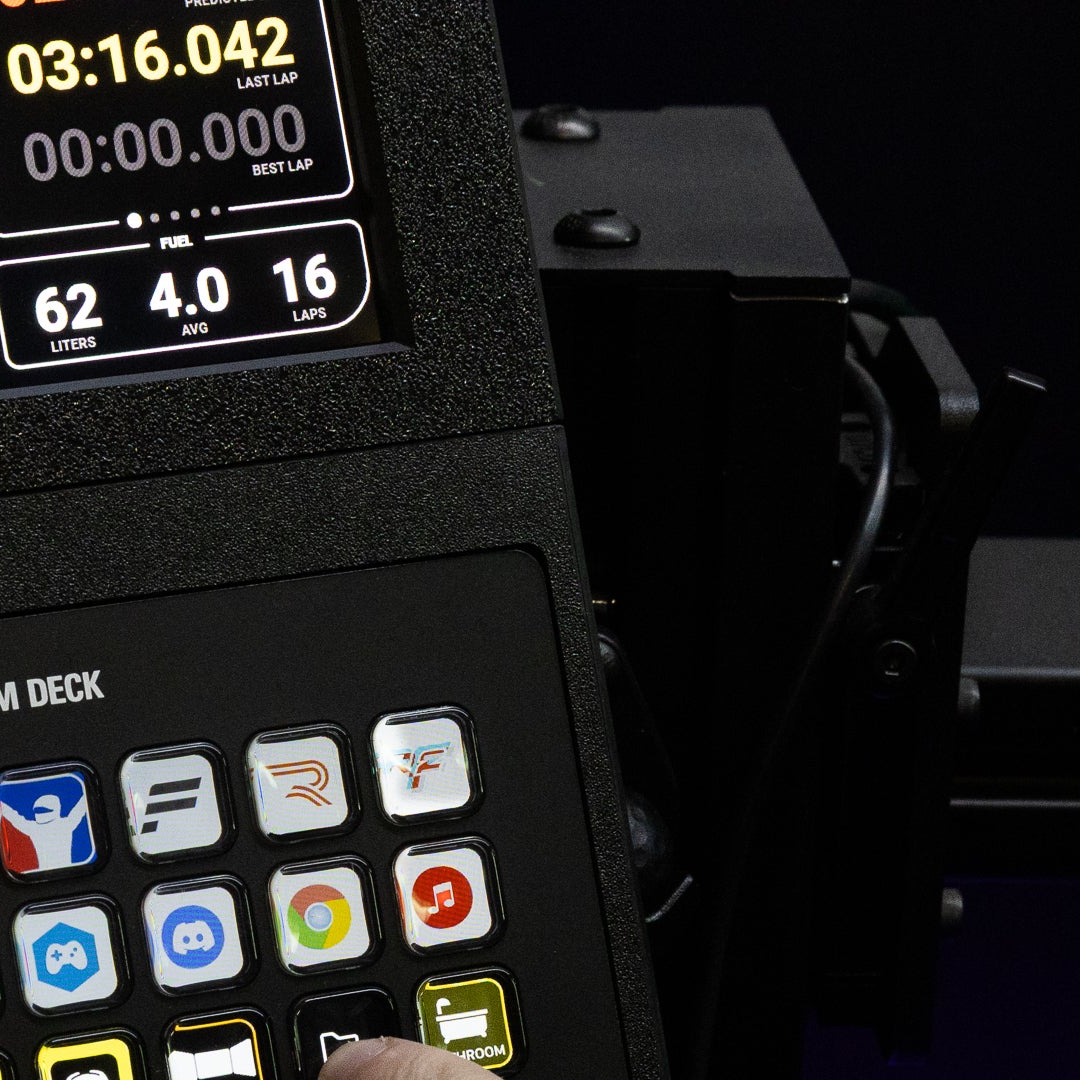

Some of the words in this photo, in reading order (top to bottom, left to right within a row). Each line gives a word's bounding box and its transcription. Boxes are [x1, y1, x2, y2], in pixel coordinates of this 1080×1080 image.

[7, 16, 296, 95] 03:16.042
[236, 73, 270, 90] LAST
[272, 71, 299, 86] LAP
[23, 103, 307, 182] 00:00.000
[252, 161, 285, 177] BEST
[288, 158, 314, 173] LAP
[160, 235, 194, 250] FUEL
[272, 253, 337, 303] 16
[149, 266, 230, 318] 4.0
[34, 282, 103, 333] 62
[292, 306, 327, 323] LAPS
[181, 322, 209, 337] AVG
[50, 335, 97, 354] LITERS
[26, 669, 105, 708] DECK
[452, 1043, 507, 1062] HROOM
